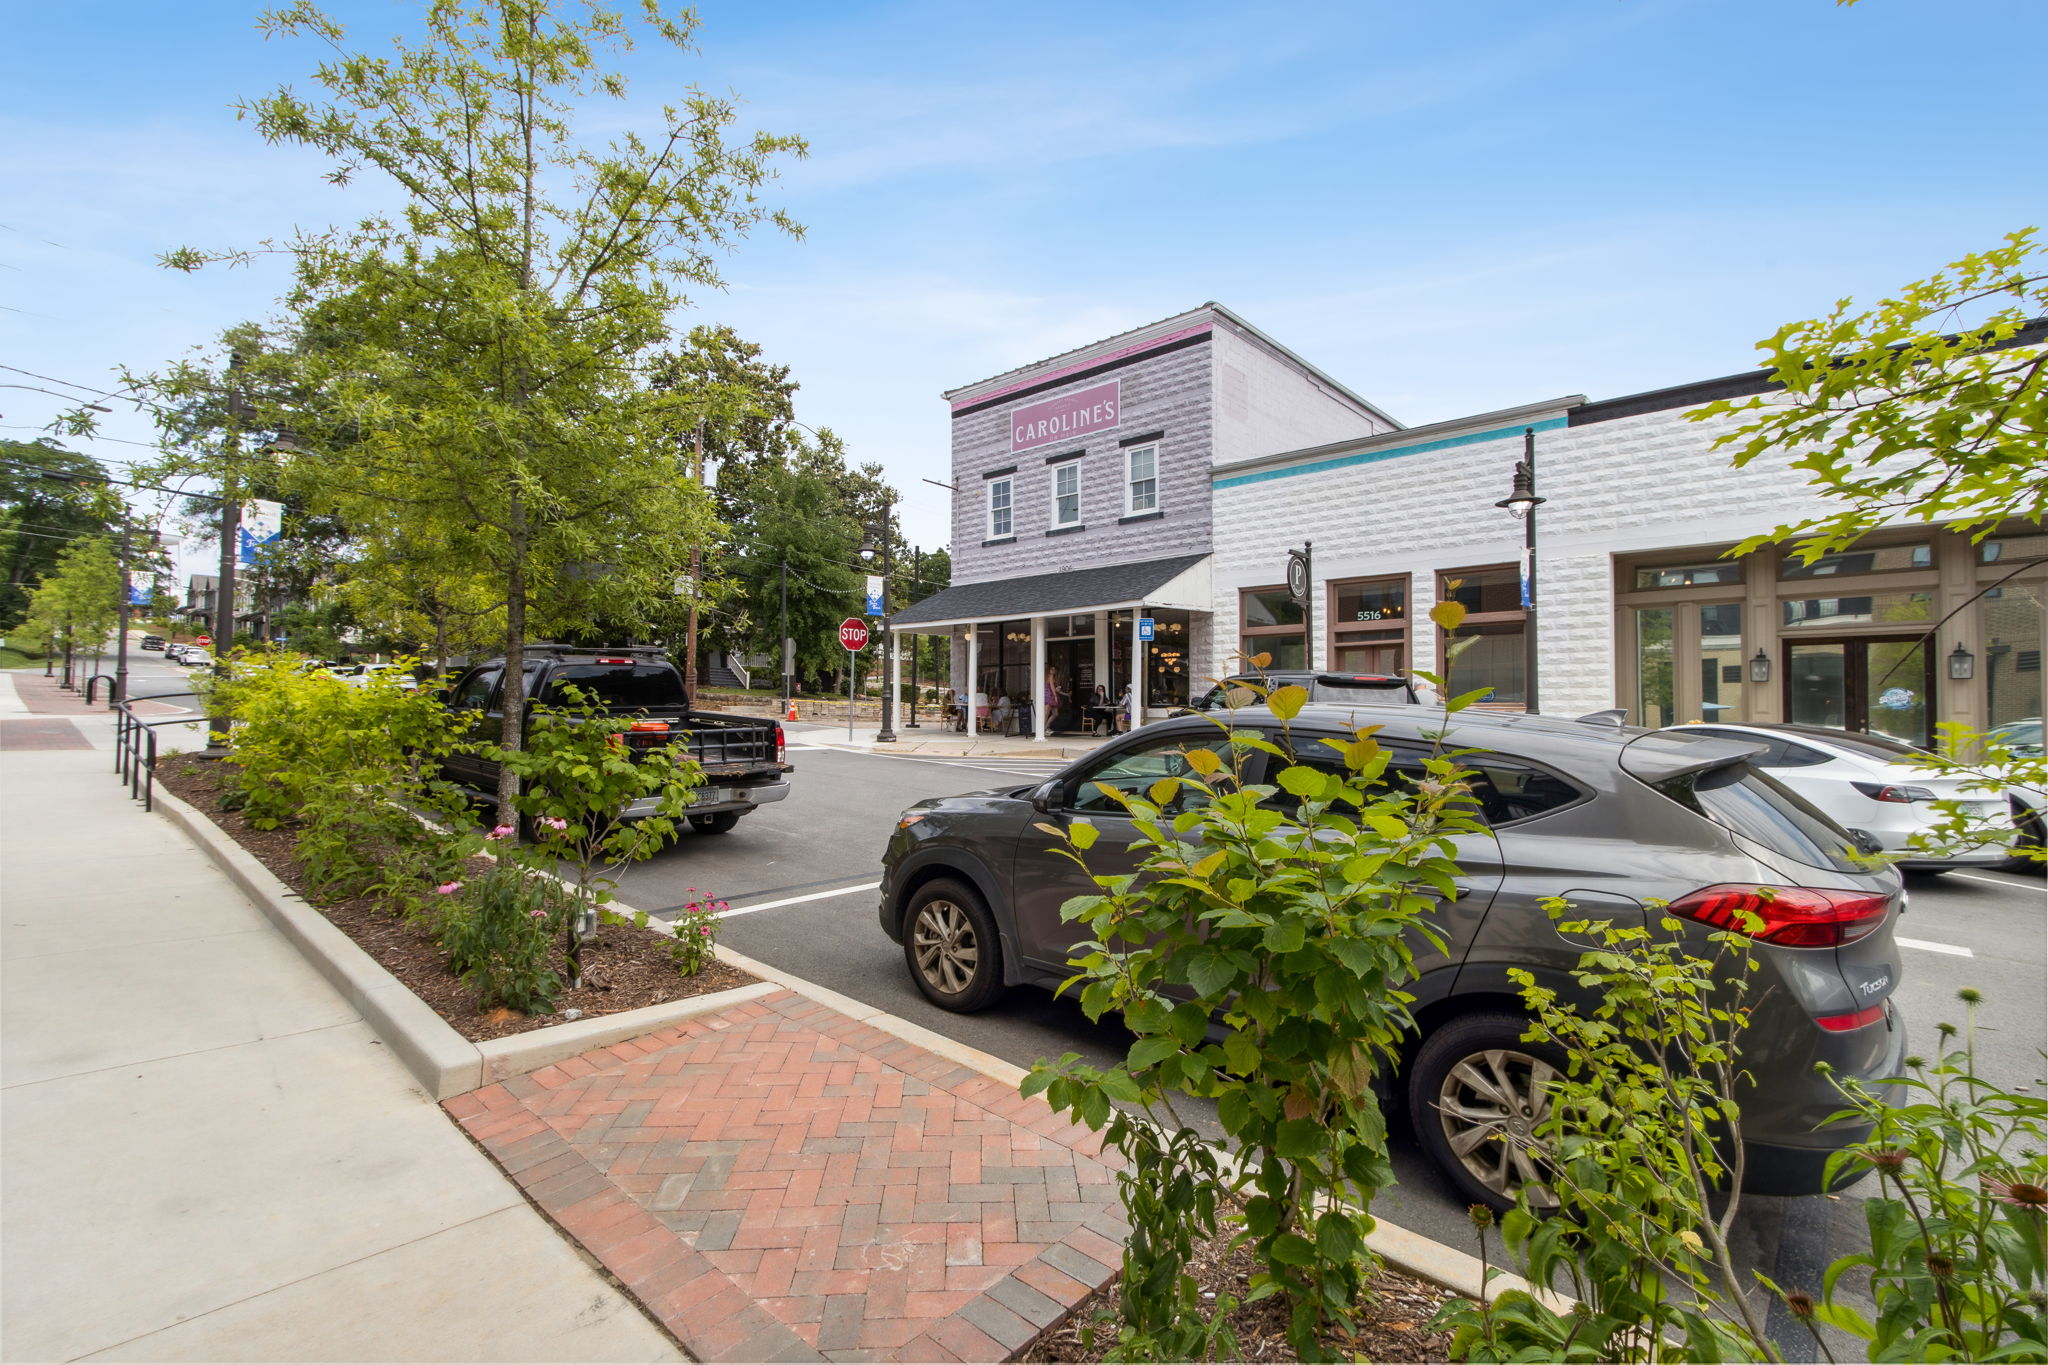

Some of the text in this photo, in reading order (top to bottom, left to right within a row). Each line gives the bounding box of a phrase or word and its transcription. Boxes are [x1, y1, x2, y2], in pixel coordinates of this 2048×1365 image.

[1015, 400, 1115, 443] CAROLINE'S
[1295, 564, 1302, 585] P
[1357, 611, 1381, 621] 5516
[842, 628, 867, 641] STOP
